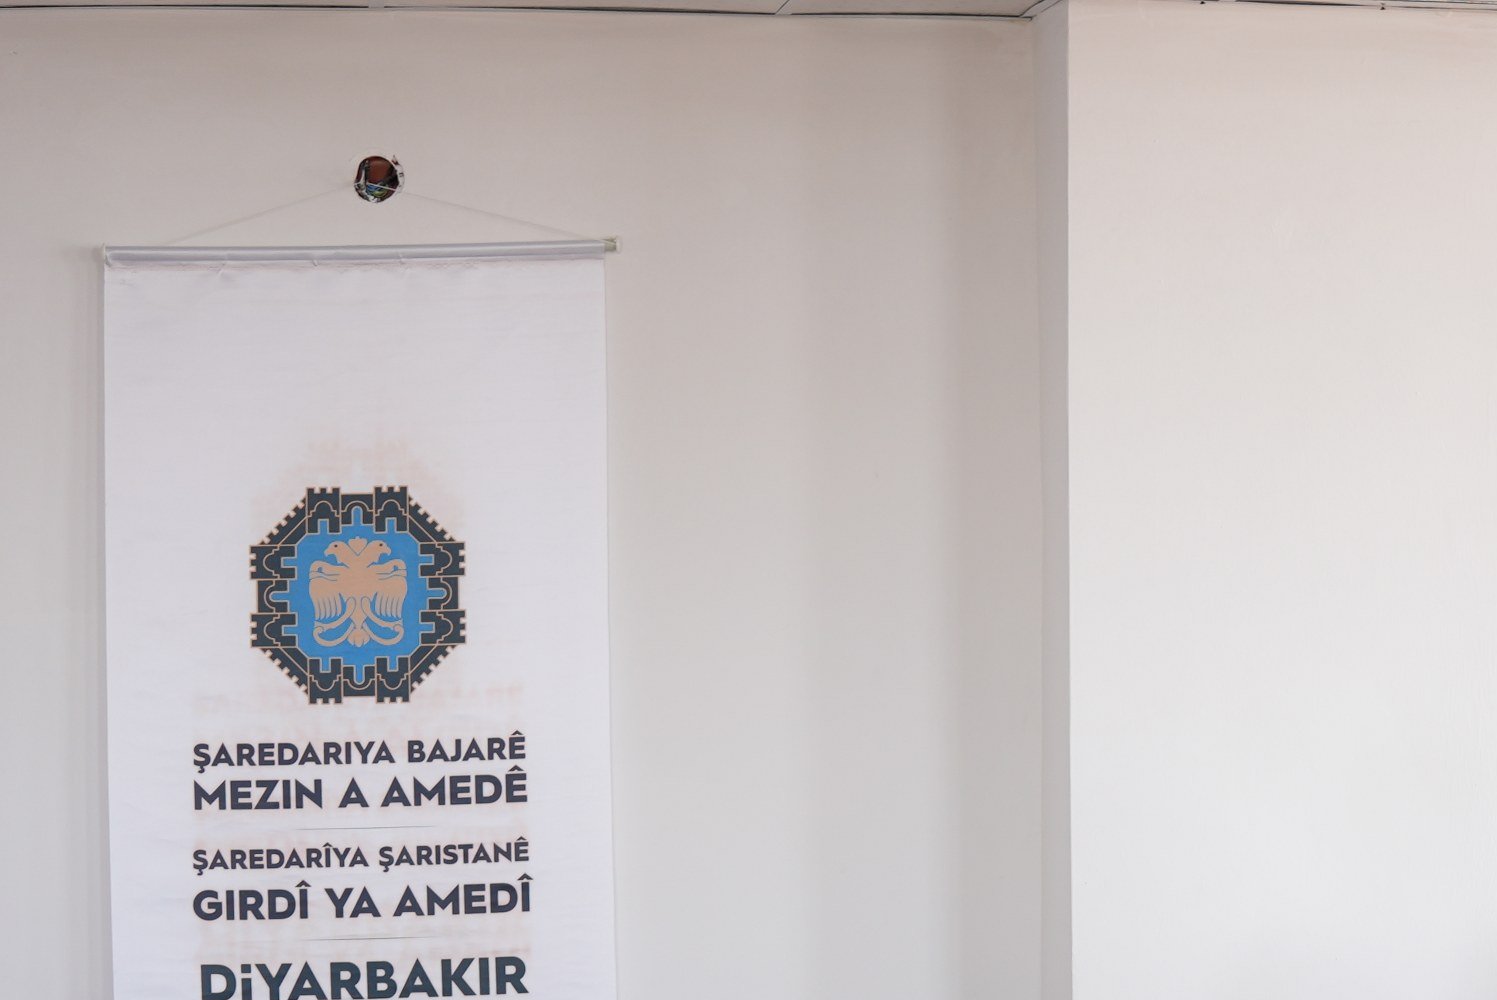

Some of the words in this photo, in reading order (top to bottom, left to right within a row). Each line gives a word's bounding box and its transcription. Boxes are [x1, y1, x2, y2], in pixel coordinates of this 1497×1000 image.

[193, 740, 396, 774] ŞAREDARIYA
[407, 730, 527, 763] BAJARÊ
[193, 778, 323, 811] MEZIN
[338, 777, 370, 809] A
[380, 764, 528, 808] AMEDÊ
[192, 842, 370, 876] ŞAREDARÎYA
[378, 835, 530, 873] ŞARISTANÊ
[192, 879, 312, 922] GIRDÎ
[324, 886, 382, 919] YA
[392, 873, 534, 917] AMEDÎ
